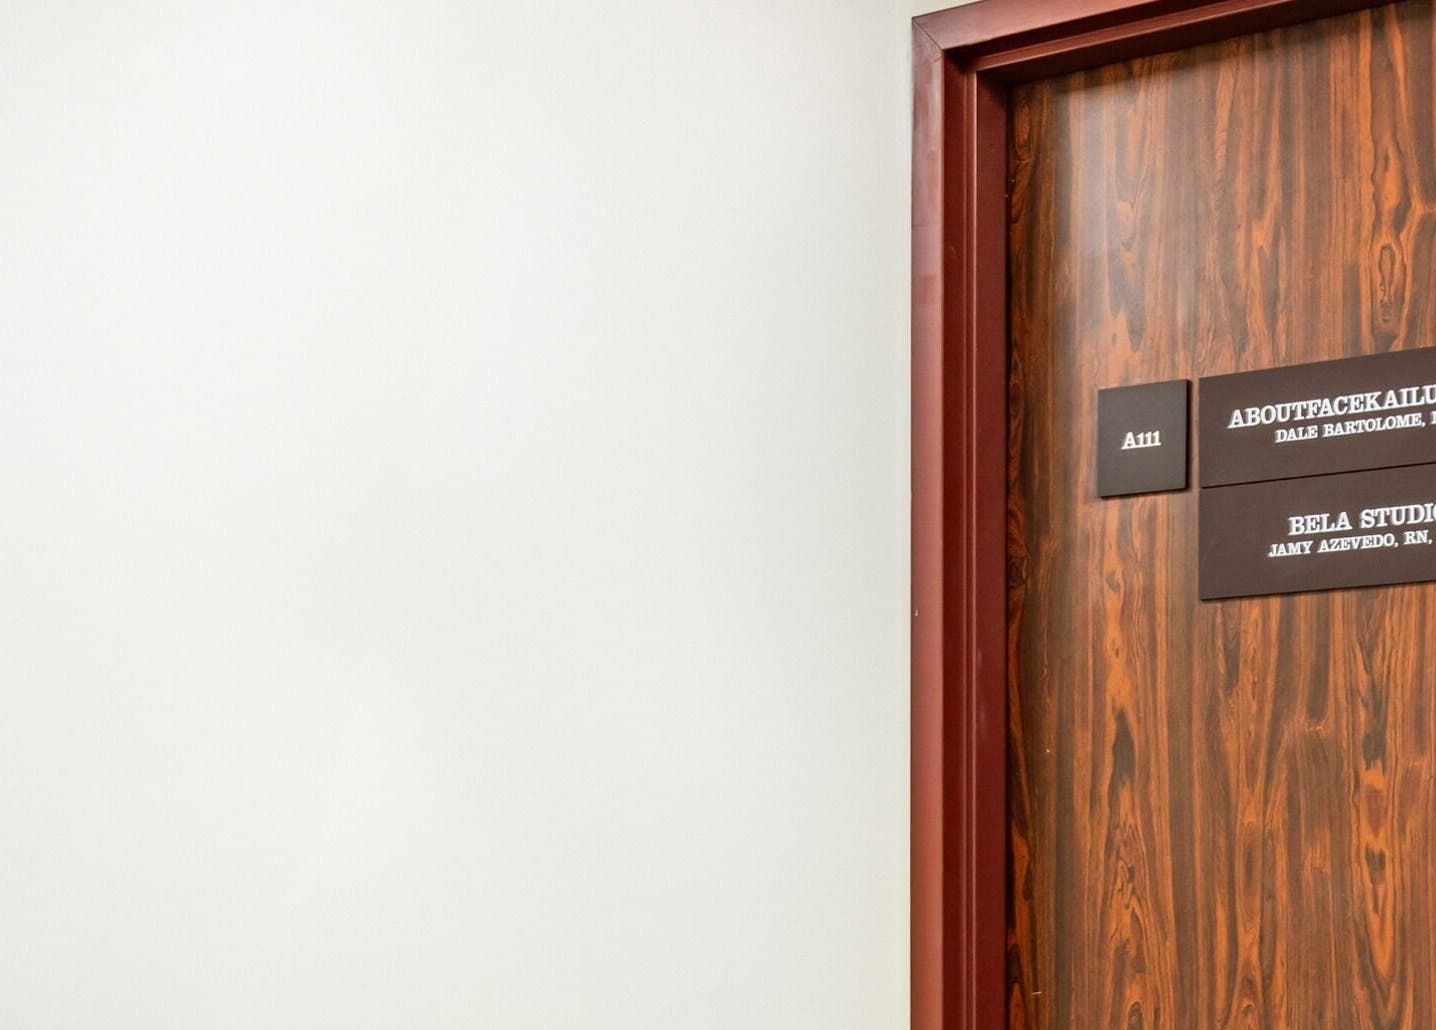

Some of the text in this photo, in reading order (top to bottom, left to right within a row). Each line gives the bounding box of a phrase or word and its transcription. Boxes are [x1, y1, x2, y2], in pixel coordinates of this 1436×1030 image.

[1120, 430, 1162, 450] A111
[1275, 425, 1318, 443] DALE
[1322, 412, 1426, 437] BARTOLOME,
[1288, 511, 1353, 535] BELA
[1268, 540, 1314, 558] JAMY
[1317, 533, 1399, 553] AZEVEDO,
[1403, 529, 1433, 545] RN,
